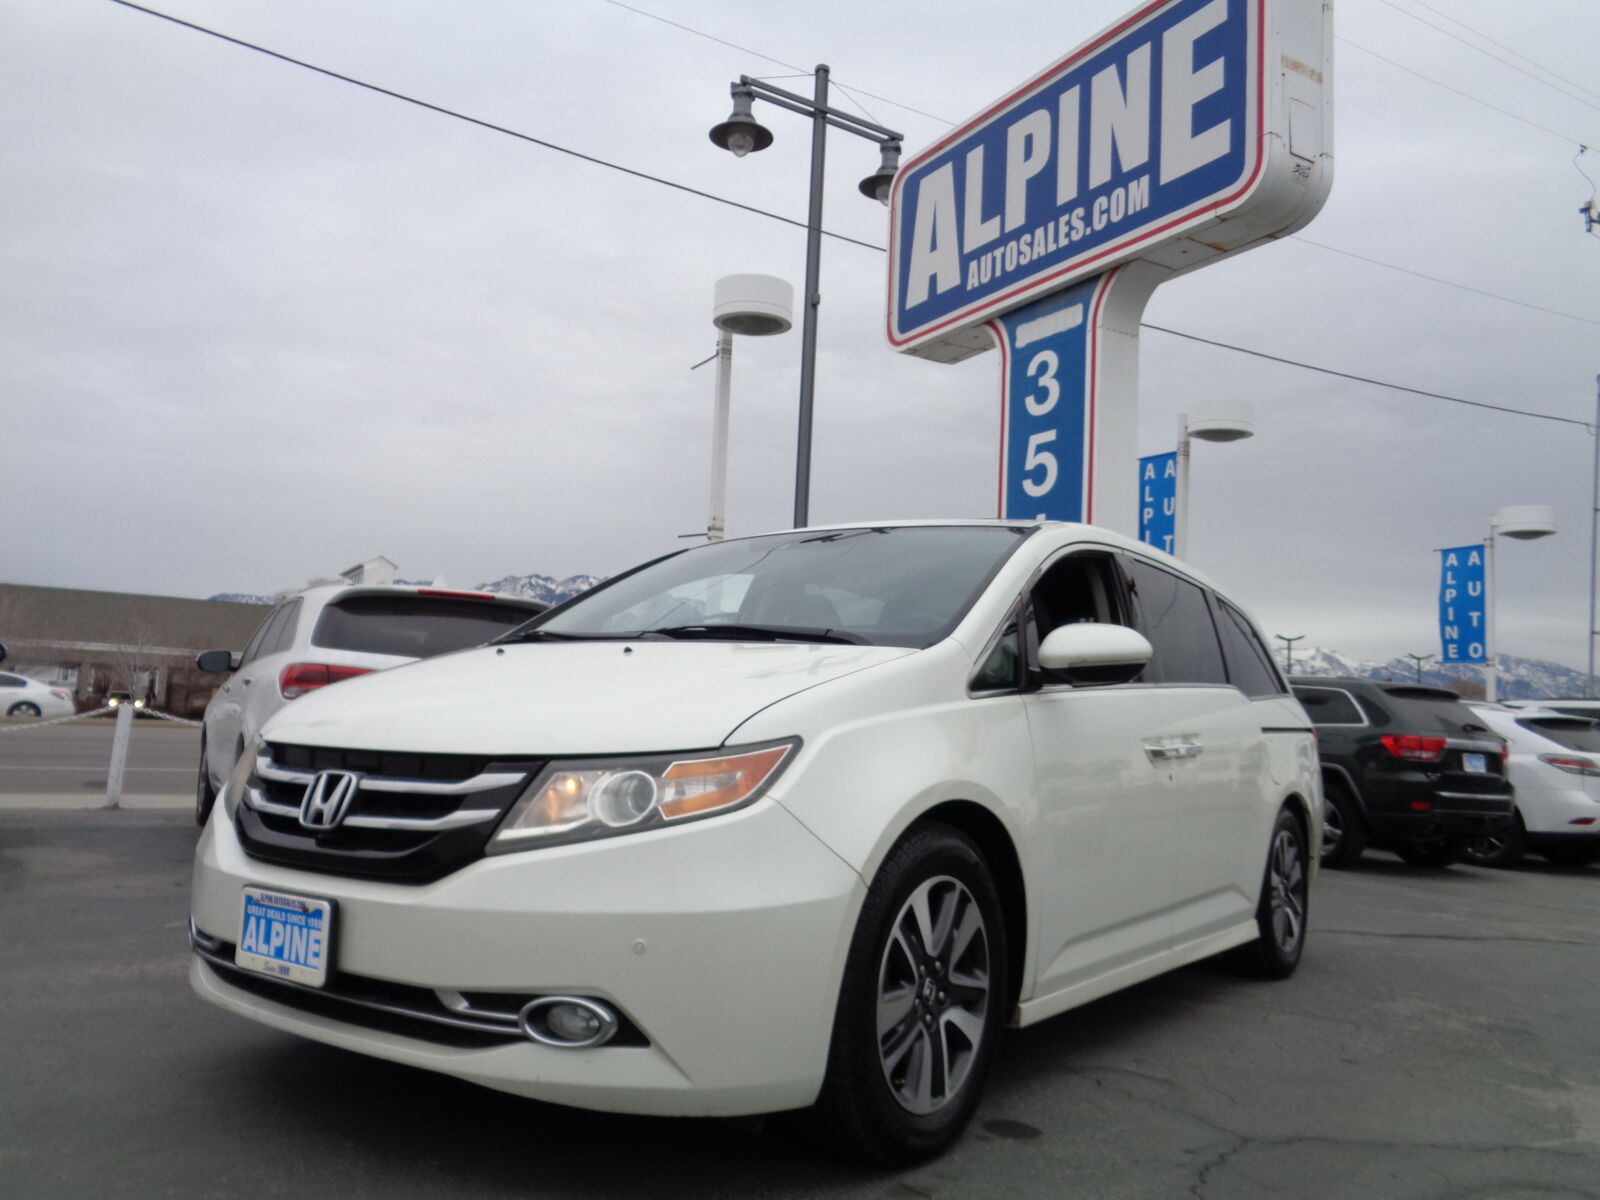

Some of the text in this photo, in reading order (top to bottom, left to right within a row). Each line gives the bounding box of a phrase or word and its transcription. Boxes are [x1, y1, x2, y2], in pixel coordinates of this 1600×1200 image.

[905, 0, 1231, 311] ALPINE
[966, 175, 1150, 291] AUTOSALES.COM
[1445, 553, 1459, 659] ALPINE
[1467, 550, 1483, 658] AUTO
[242, 916, 322, 968] ALPINE
